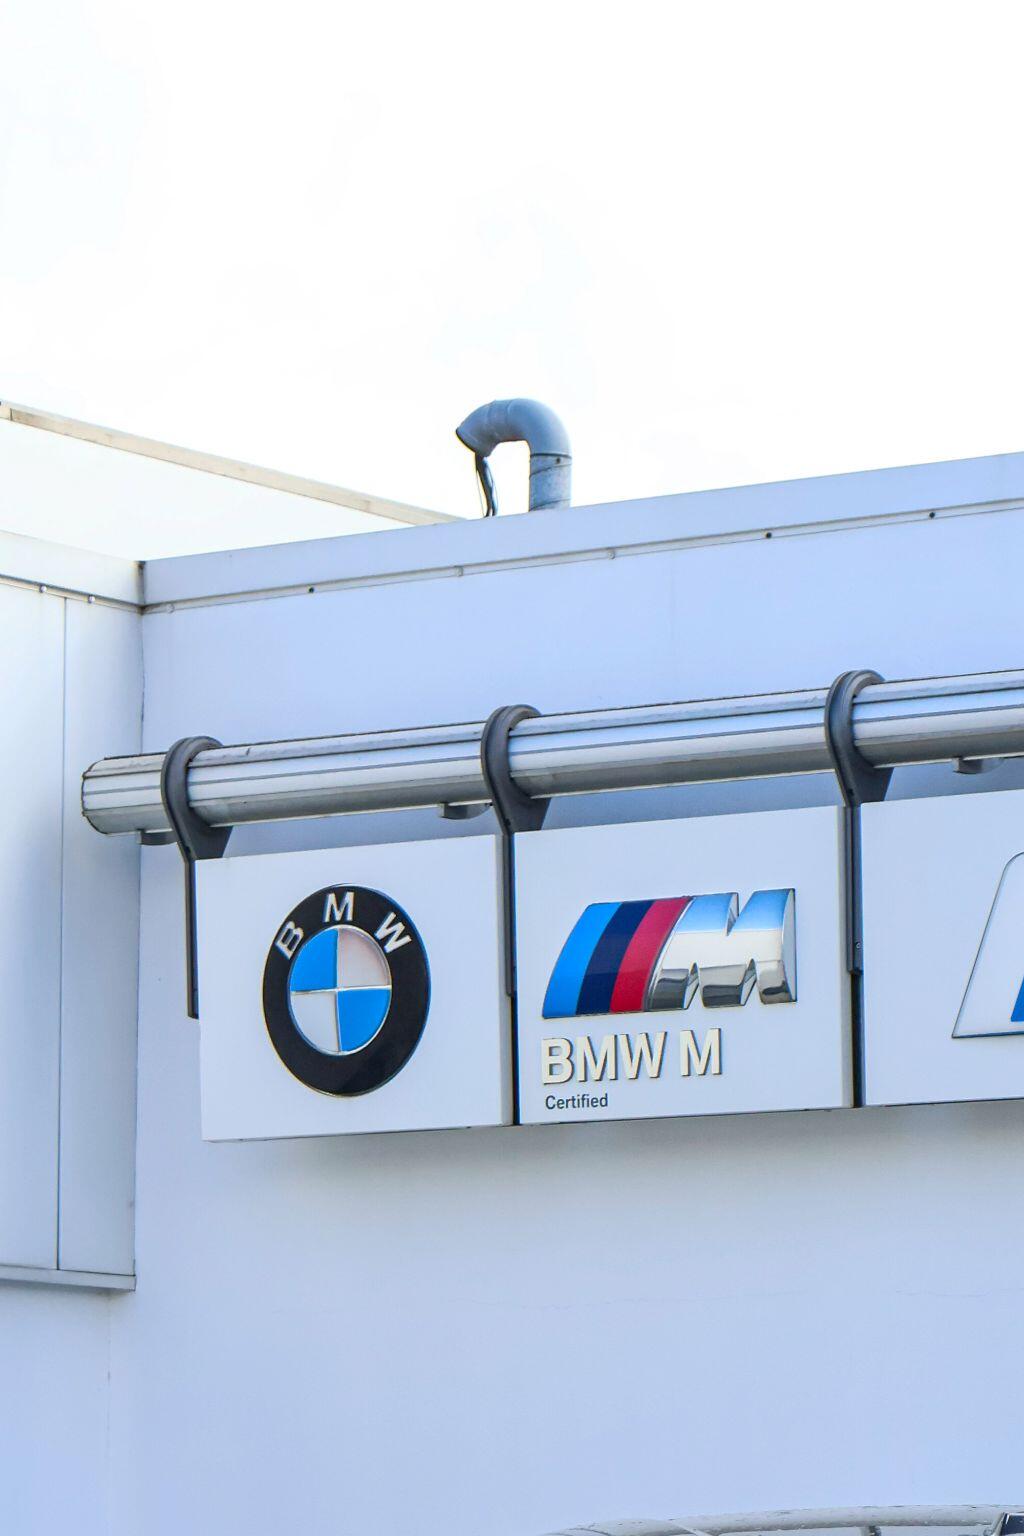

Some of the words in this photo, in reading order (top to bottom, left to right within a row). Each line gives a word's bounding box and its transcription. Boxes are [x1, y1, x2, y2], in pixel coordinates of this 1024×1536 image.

[274, 891, 413, 960] BMW
[541, 1031, 668, 1085] BMW
[679, 1027, 722, 1077] M
[545, 1093, 608, 1110] Certified
